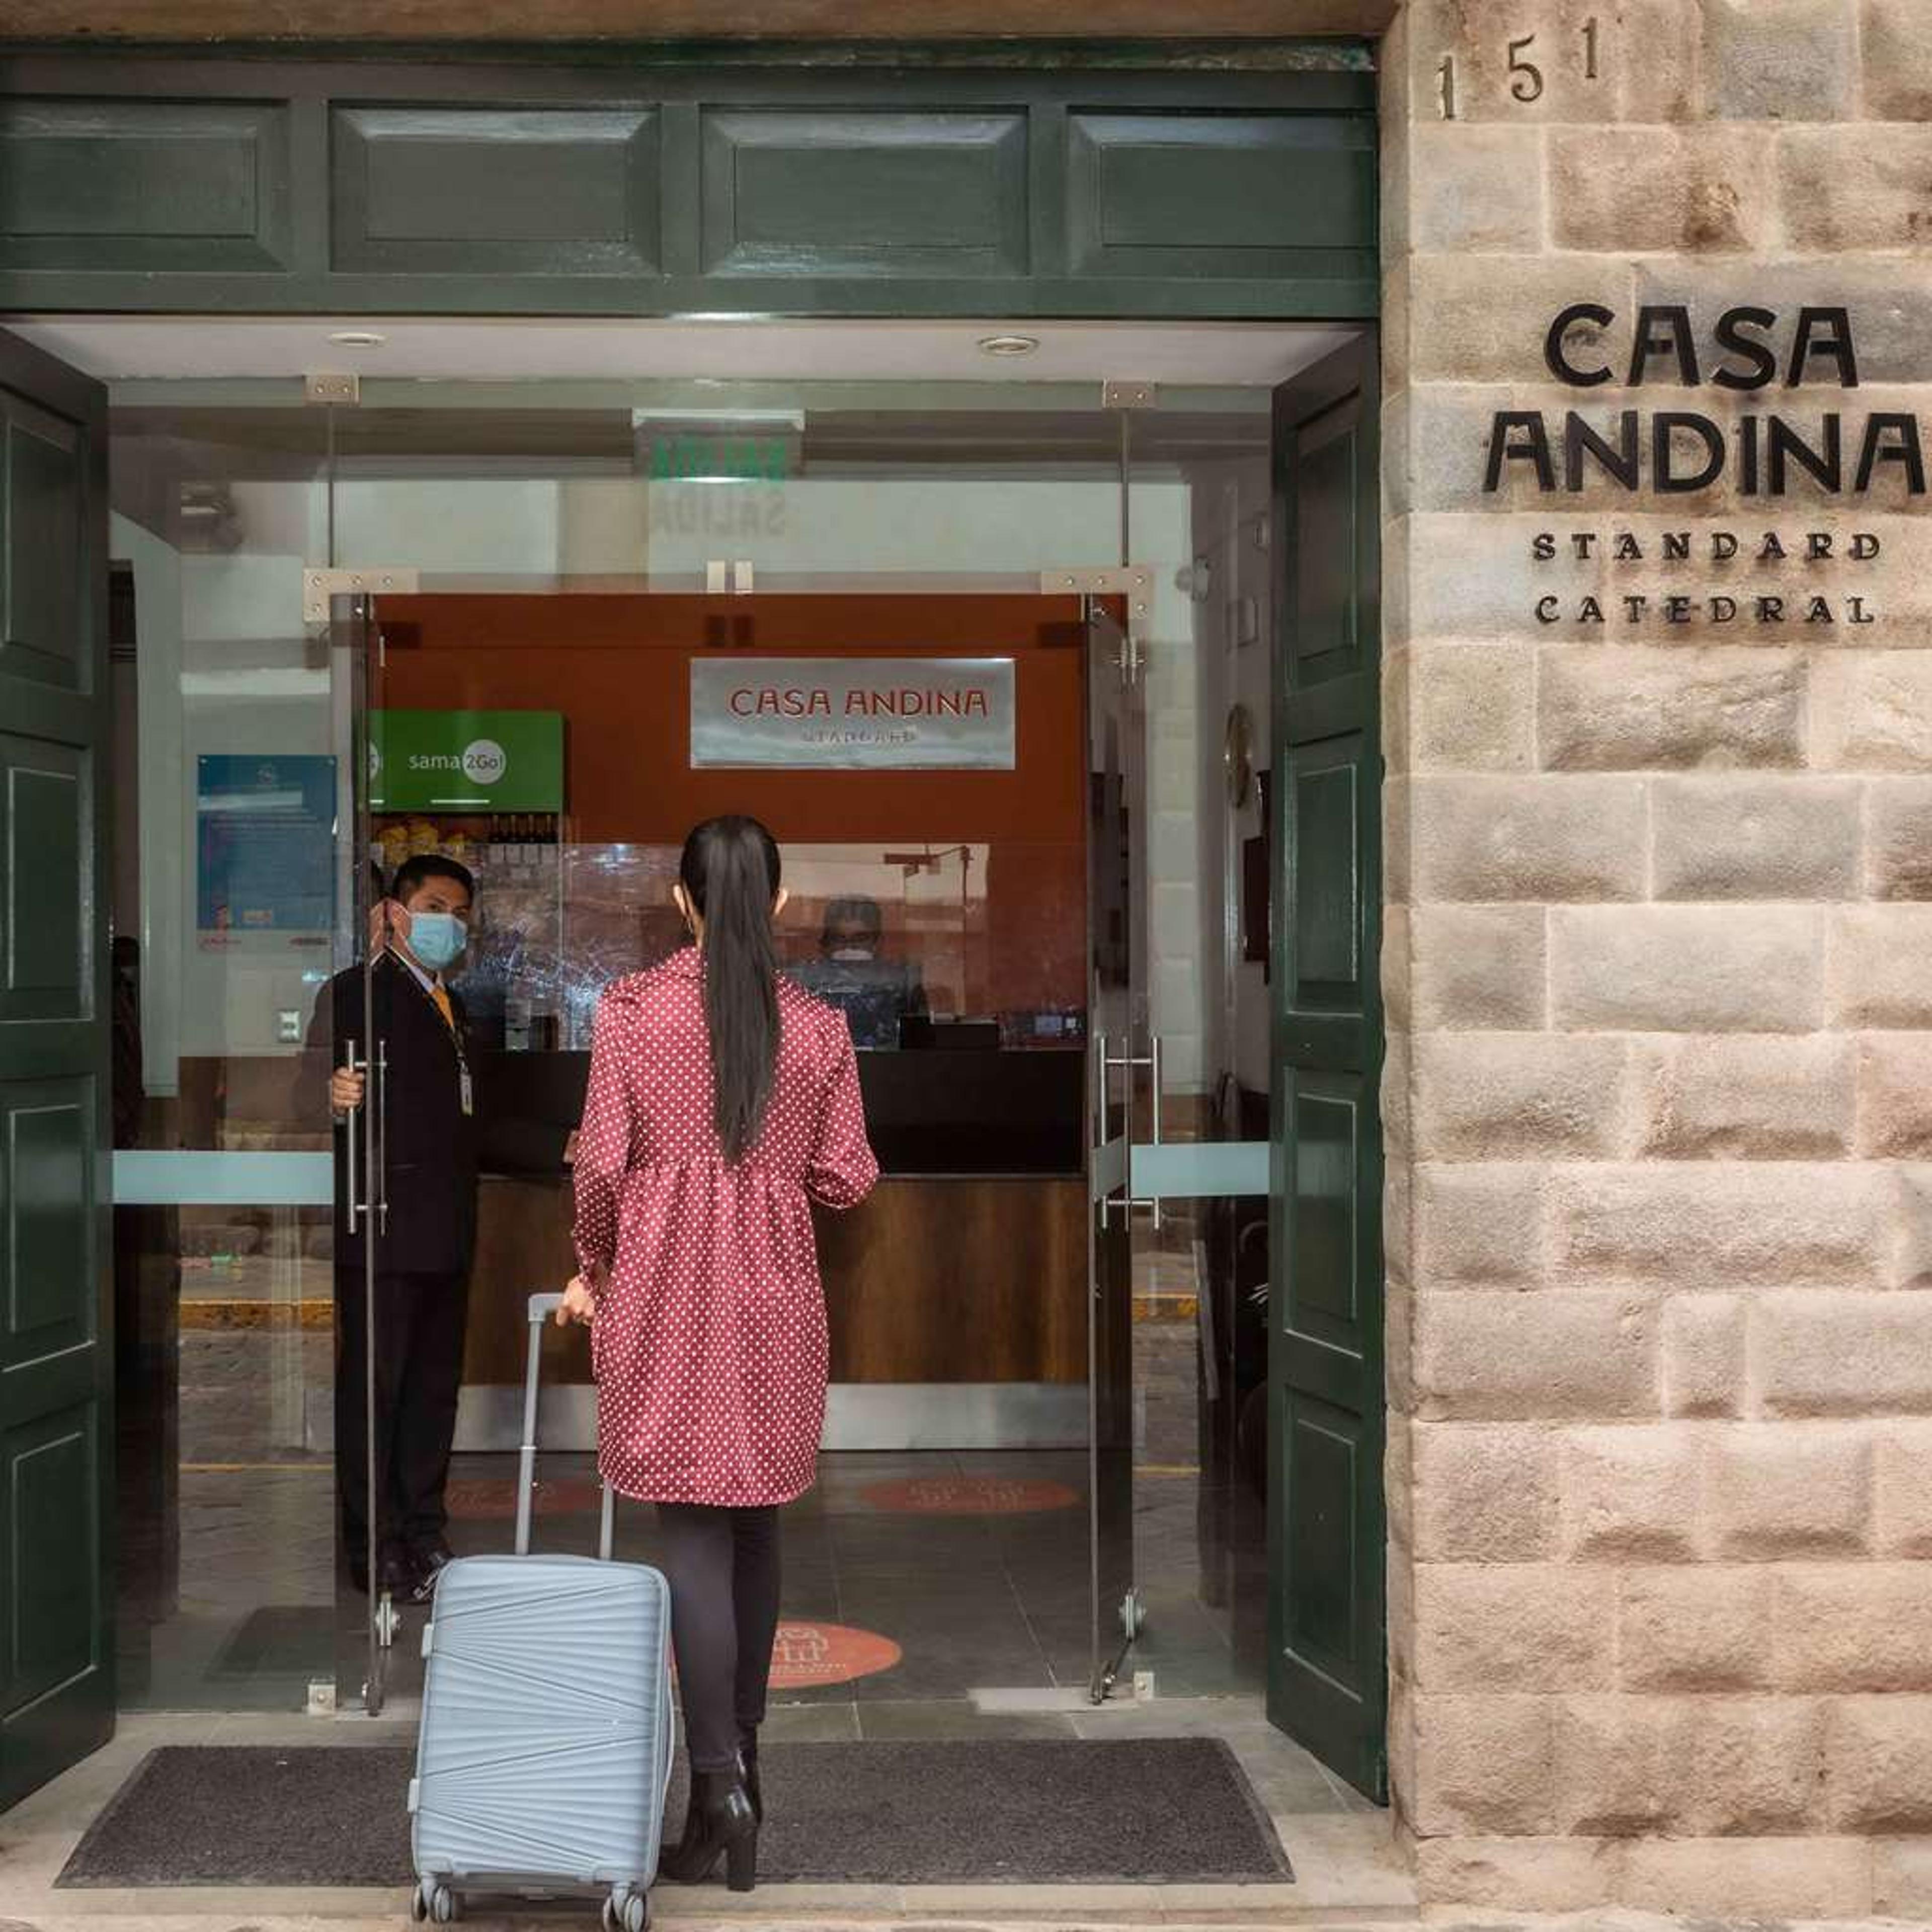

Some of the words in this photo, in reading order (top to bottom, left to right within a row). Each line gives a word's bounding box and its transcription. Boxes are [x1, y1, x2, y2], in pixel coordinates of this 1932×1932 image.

[1435, 17, 1599, 121] 151
[1544, 303, 1859, 390] CASA
[1482, 410, 1926, 496] ANDINA
[1532, 532, 1881, 560] STANDARD
[1535, 596, 1875, 623] CATEDRAL
[731, 688, 832, 716] CASA
[844, 688, 988, 717] ANDINA
